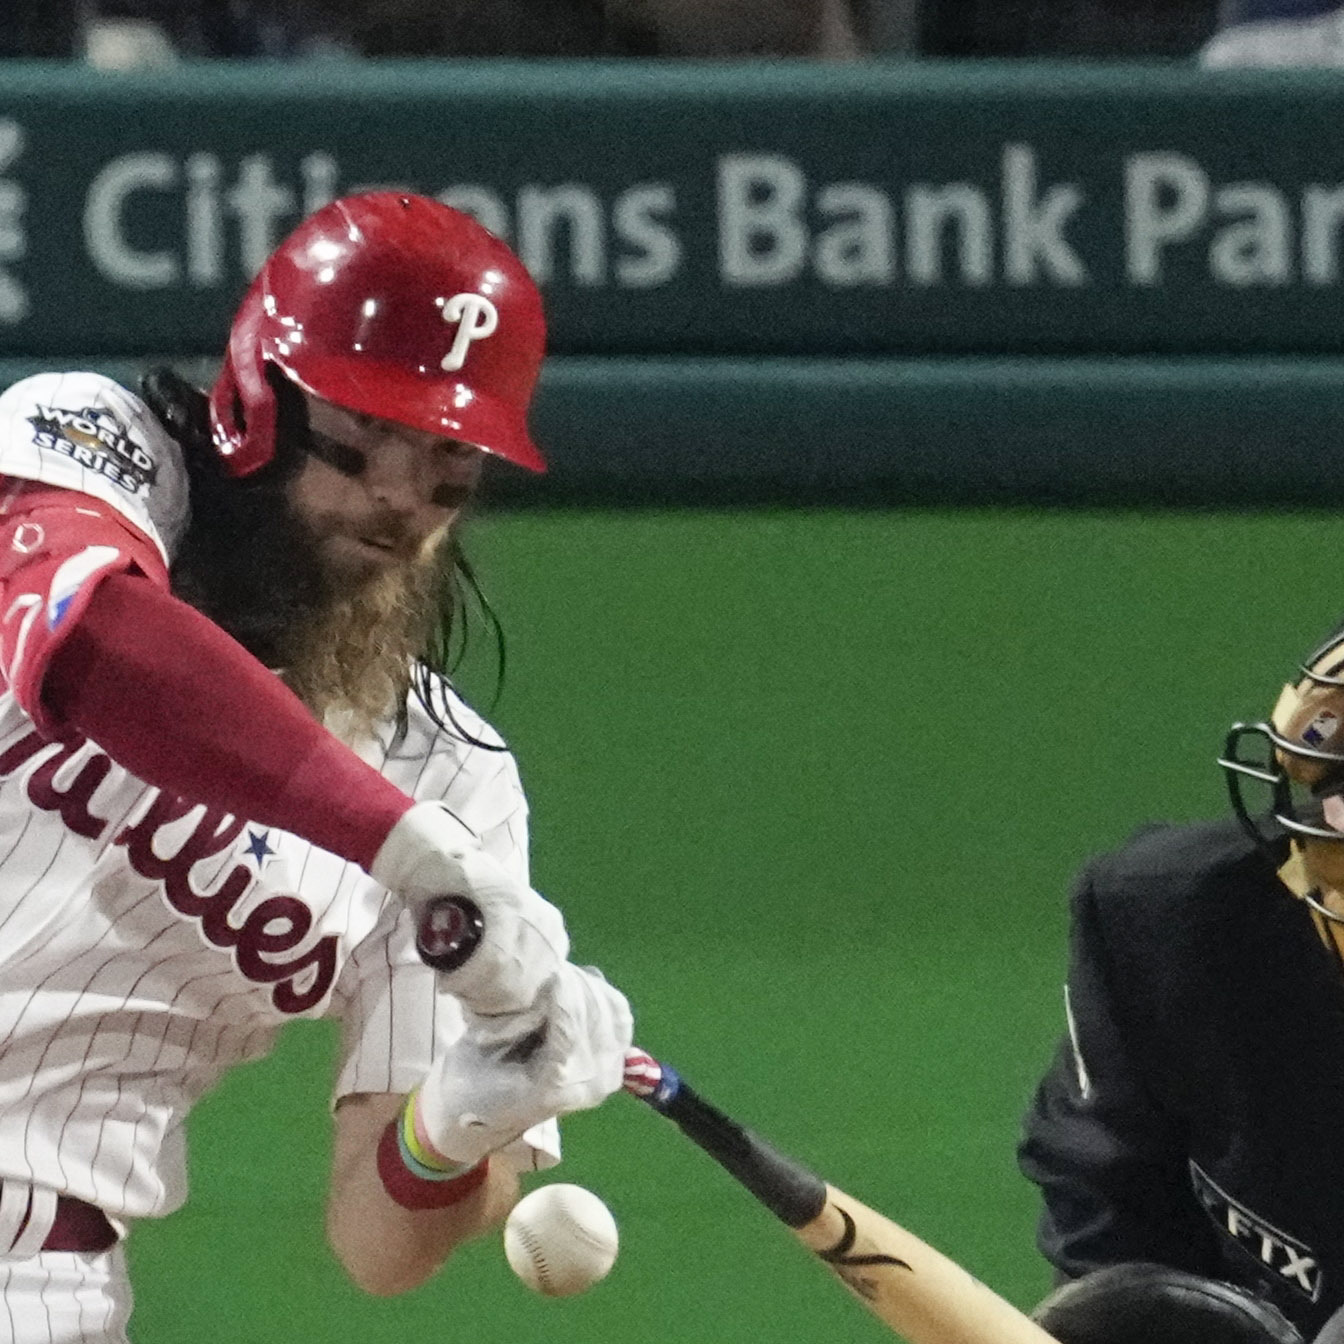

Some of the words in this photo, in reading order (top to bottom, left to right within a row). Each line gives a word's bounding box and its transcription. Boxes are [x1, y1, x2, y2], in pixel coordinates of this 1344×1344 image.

[83, 152, 682, 287] Citins
[716, 143, 1088, 287] Bank
[441, 292, 498, 371] P
[33, 431, 138, 494] SERIES
[39, 404, 153, 471] WORLD
[1228, 1206, 1315, 1291] FTX
